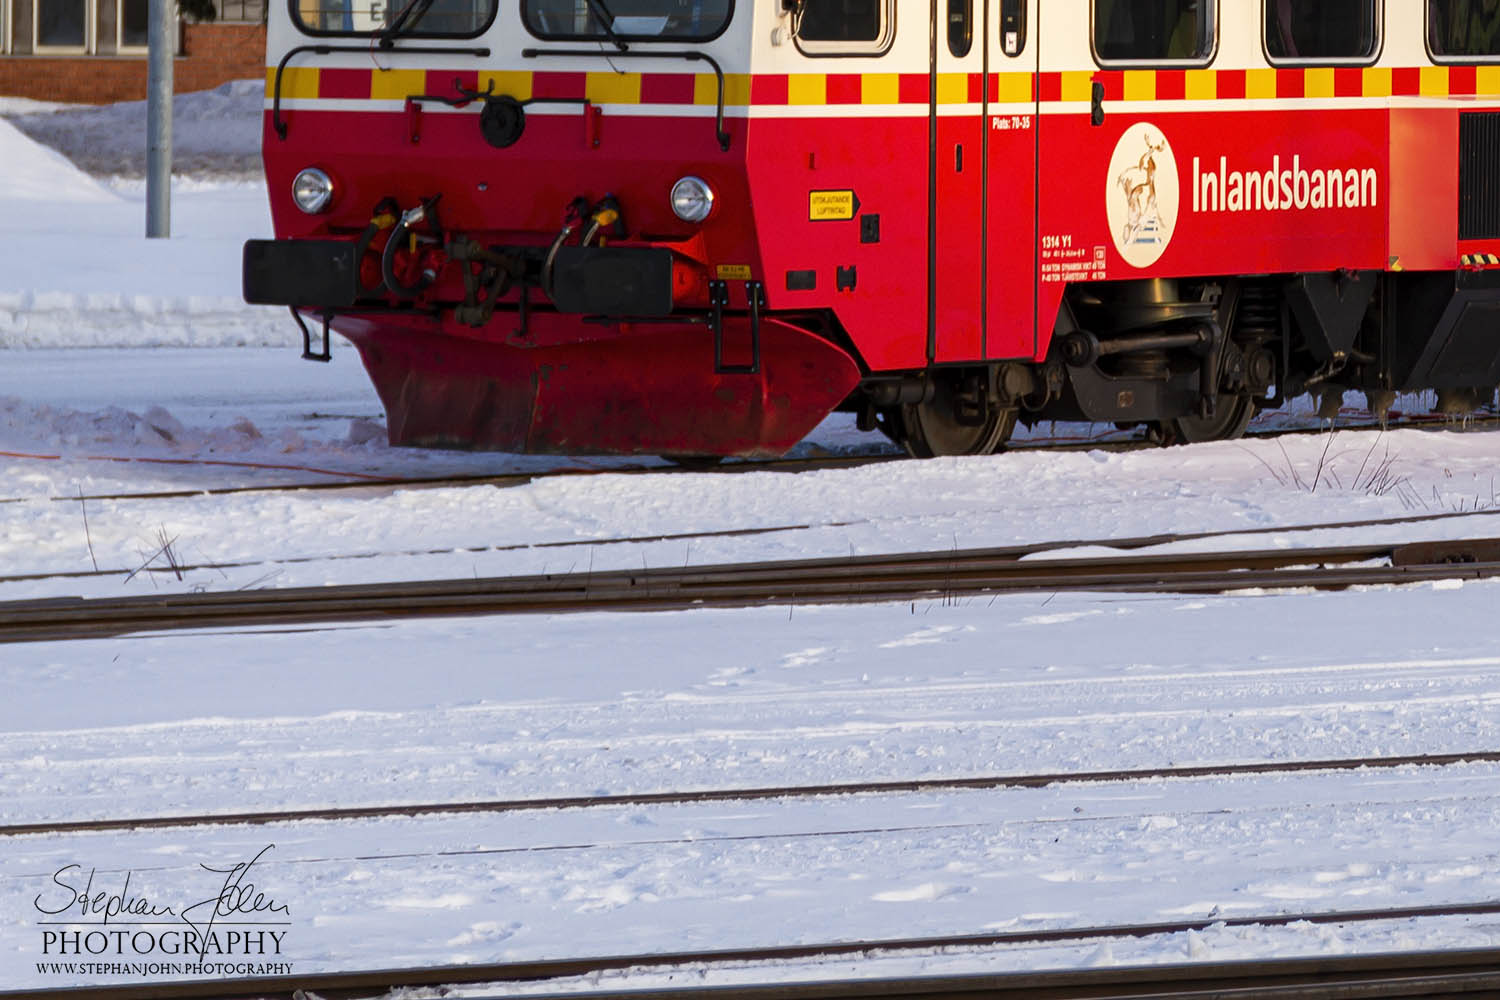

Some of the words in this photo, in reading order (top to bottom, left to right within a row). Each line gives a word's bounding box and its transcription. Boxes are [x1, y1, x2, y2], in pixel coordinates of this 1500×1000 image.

[992, 116, 1011, 130] Plats:
[1012, 116, 1030, 129] 70-35
[1193, 154, 1377, 212] Inlandsbanan
[1042, 235, 1060, 249] 1314
[1062, 234, 1072, 248] Y1
